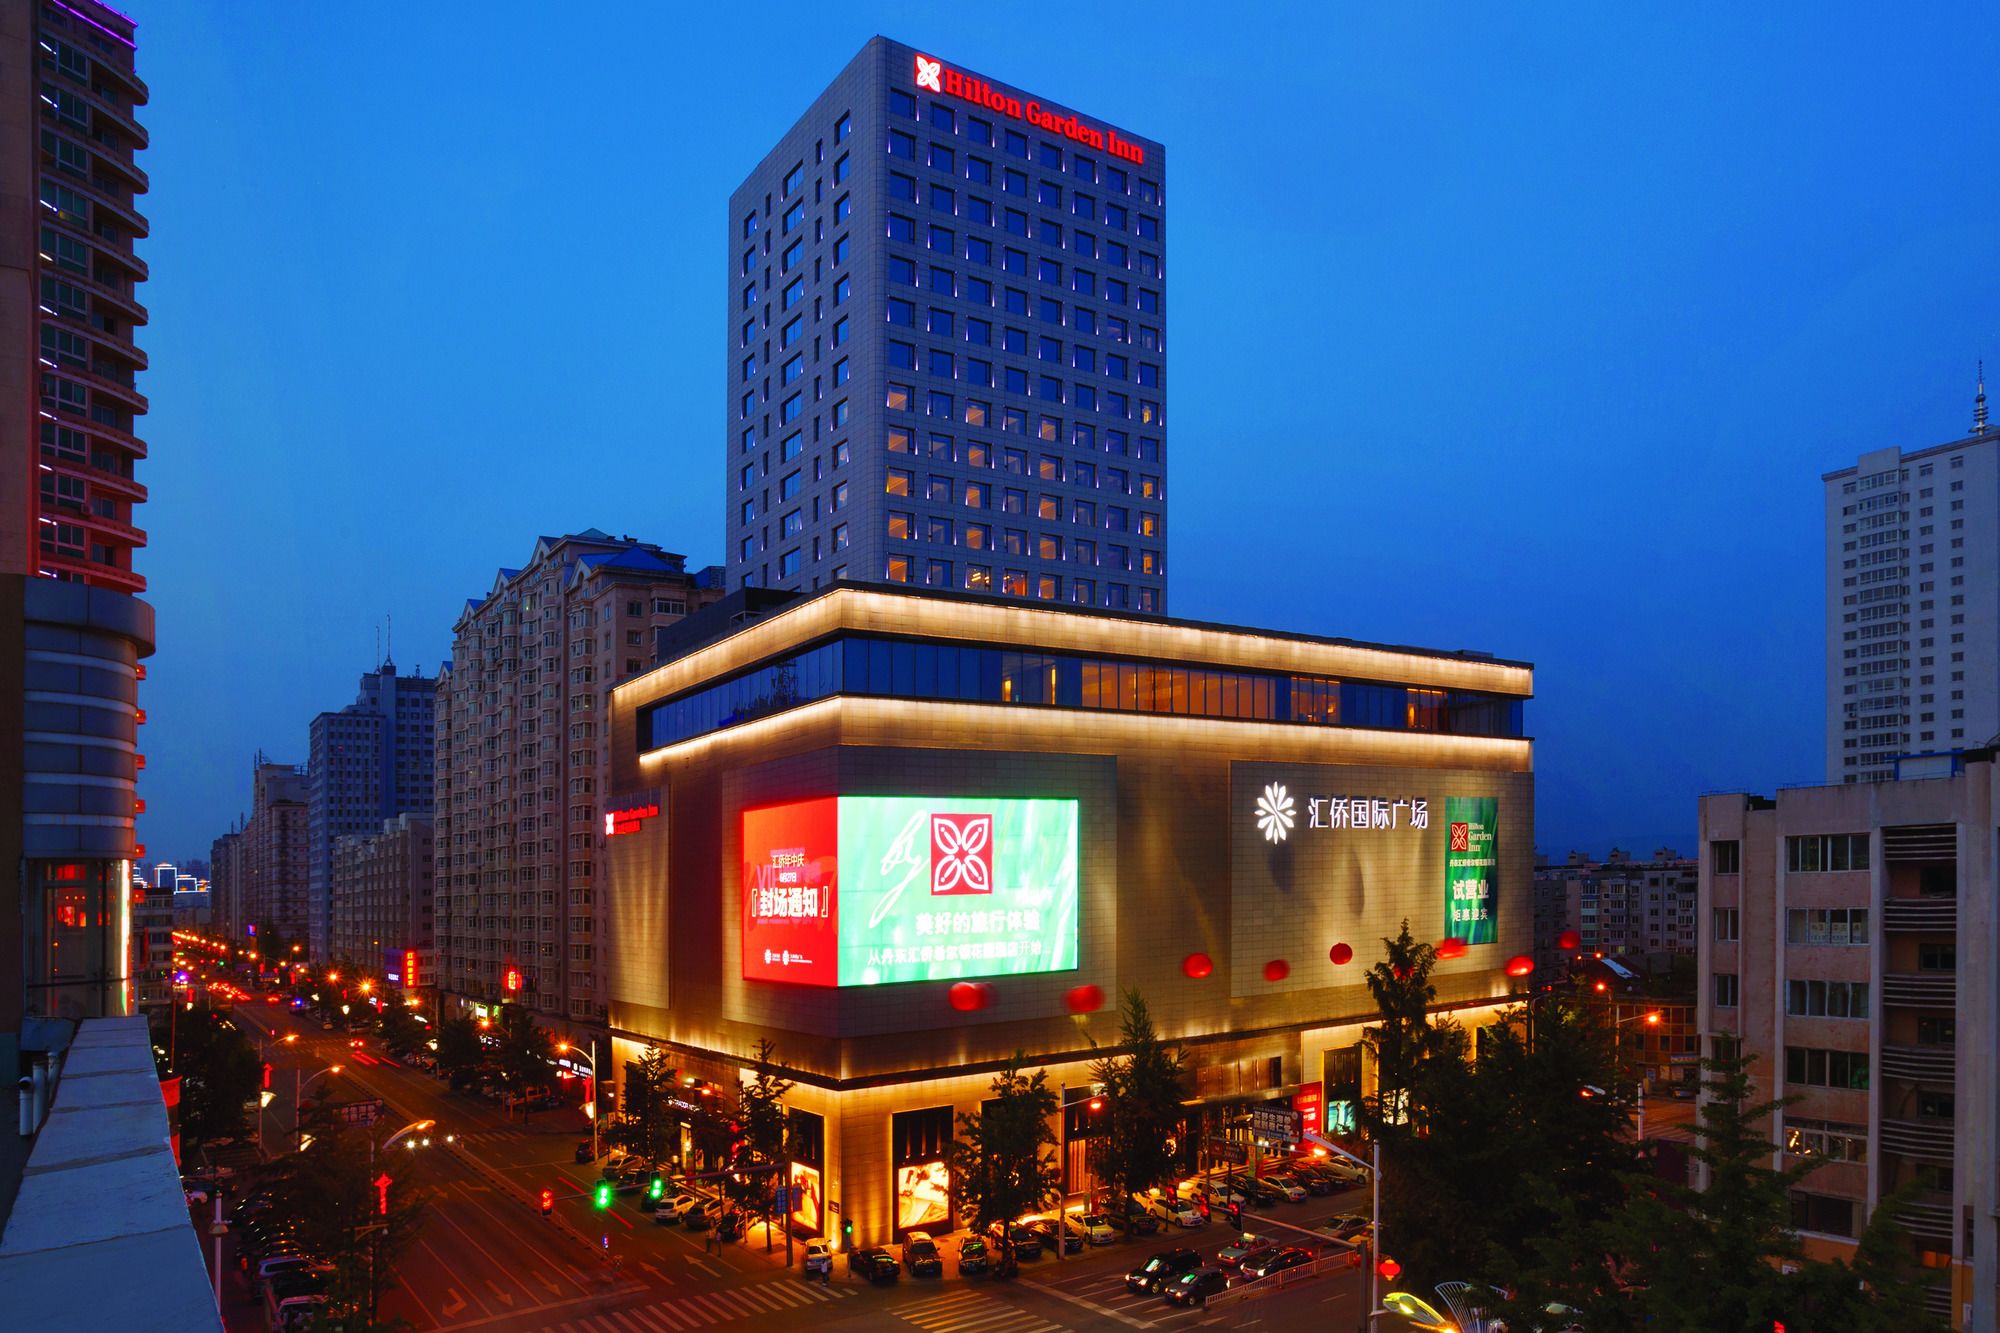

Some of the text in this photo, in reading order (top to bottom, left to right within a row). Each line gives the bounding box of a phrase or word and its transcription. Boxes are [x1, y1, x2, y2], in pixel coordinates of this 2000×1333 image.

[944, 68, 1144, 164] Hilton Garden Inn
[1308, 797, 1428, 829] 汇侨国际广场
[1468, 822, 1484, 831] Hilton
[1468, 831, 1492, 841] Garden
[1468, 843, 1481, 852] Inn
[1453, 879, 1489, 900] 试营业
[915, 909, 1041, 936] 美好的旅行体验
